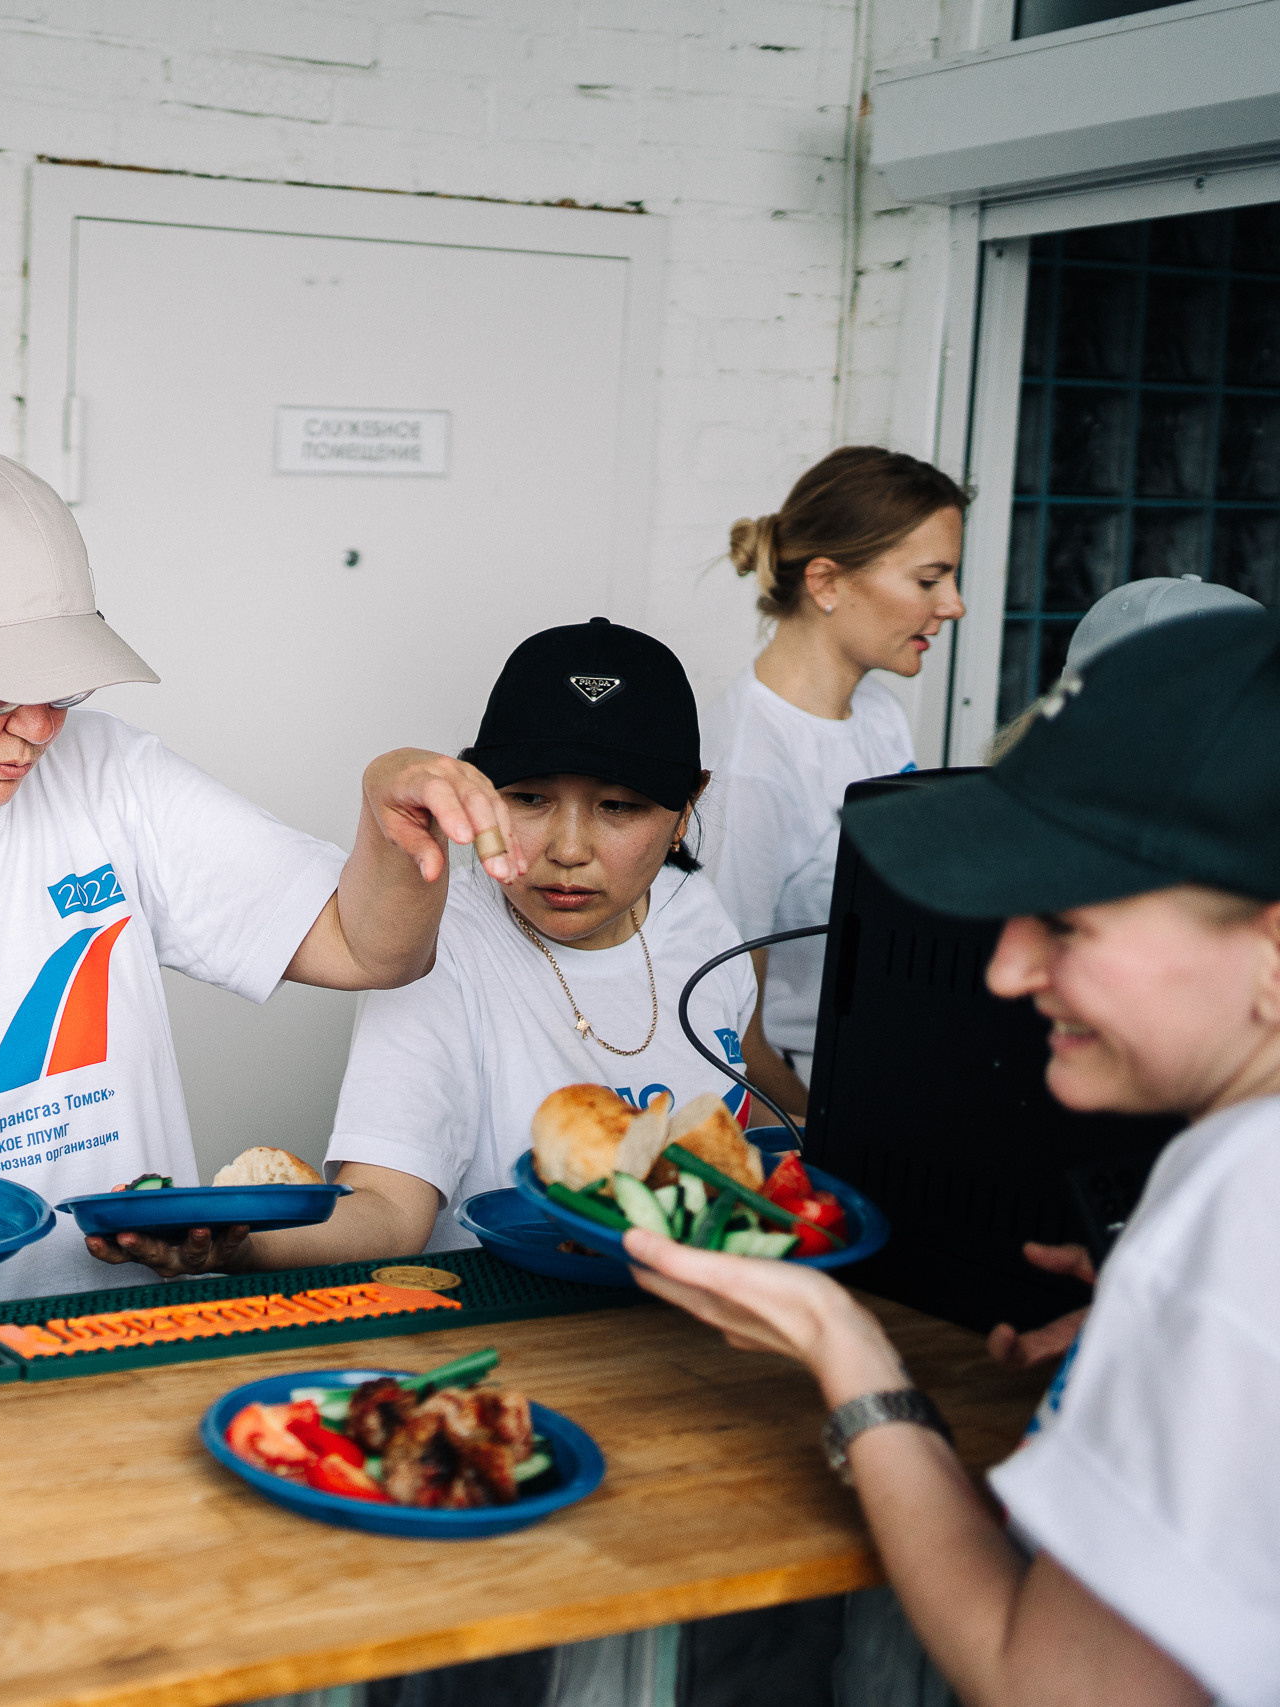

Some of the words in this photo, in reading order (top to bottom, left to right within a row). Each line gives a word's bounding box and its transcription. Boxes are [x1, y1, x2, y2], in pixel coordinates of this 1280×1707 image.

[579, 679, 611, 687] PRADA
[58, 871, 124, 910] 2022
[65, 1088, 115, 1111] Томск»
[27, 1123, 70, 1146] ЛПУМГ
[46, 1131, 119, 1161] организация
